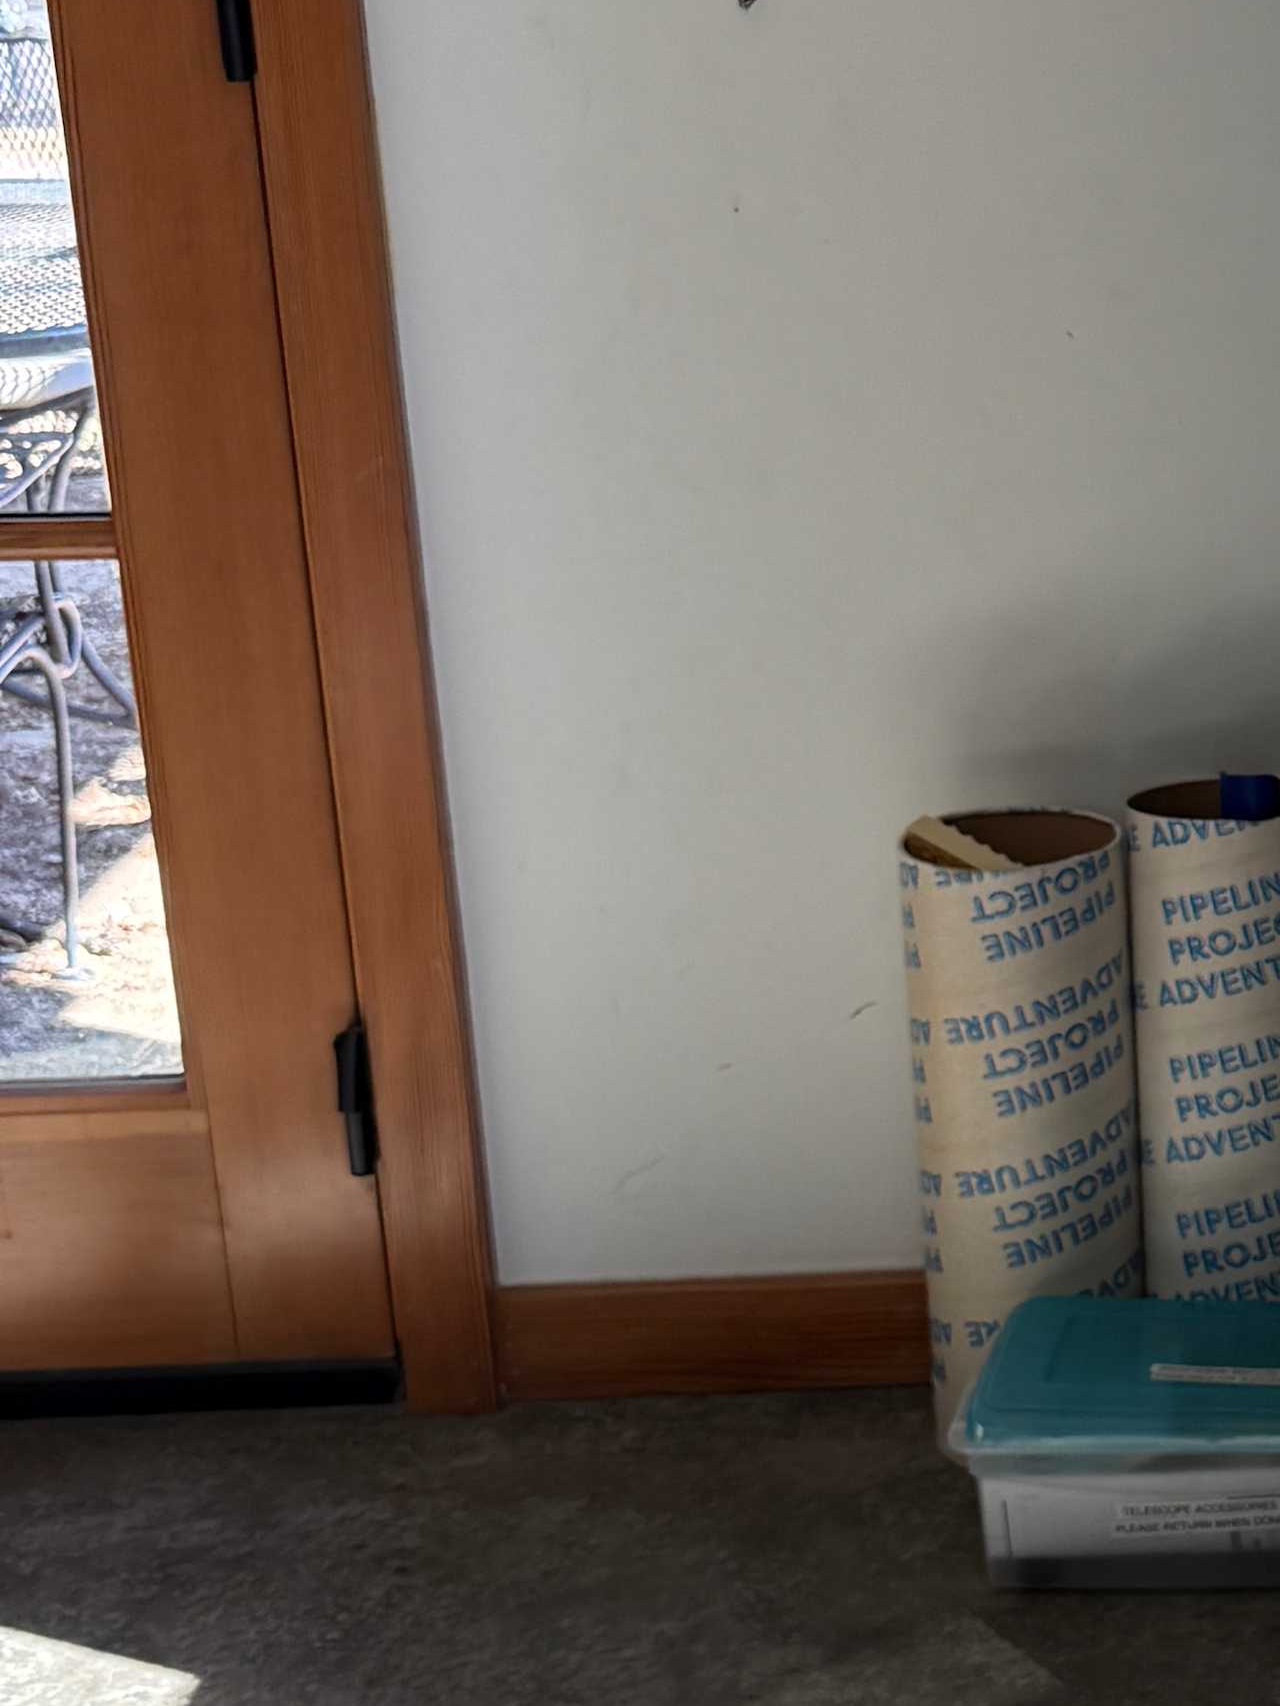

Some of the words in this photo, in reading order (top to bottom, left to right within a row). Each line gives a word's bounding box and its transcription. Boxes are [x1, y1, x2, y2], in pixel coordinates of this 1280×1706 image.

[971, 850, 1111, 923] PROJECT
[981, 880, 1116, 963] PIPELINE
[943, 948, 1123, 1045] ADVENTURE
[982, 997, 1120, 1080] PROJECT
[993, 1033, 1124, 1118] PIPELINE
[993, 1149, 1129, 1233] PROJECT
[1002, 1183, 1133, 1270] PIPELINE
